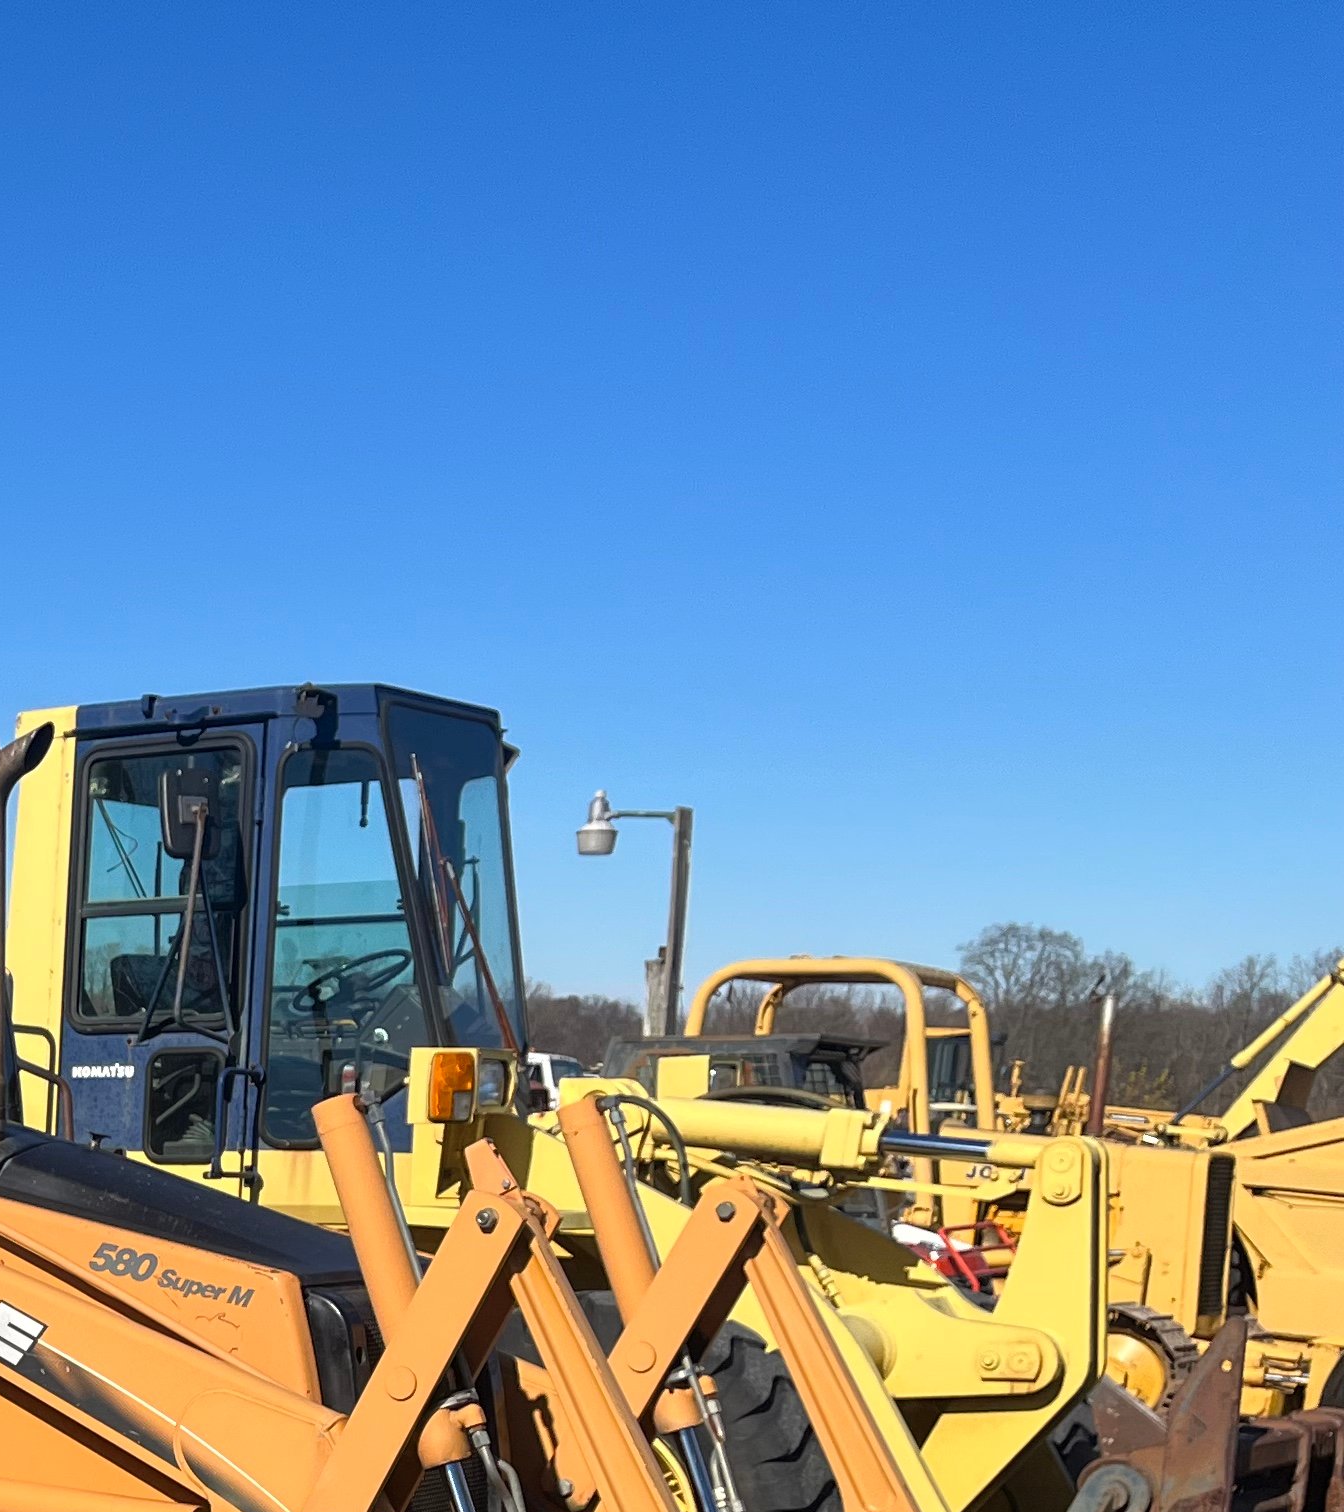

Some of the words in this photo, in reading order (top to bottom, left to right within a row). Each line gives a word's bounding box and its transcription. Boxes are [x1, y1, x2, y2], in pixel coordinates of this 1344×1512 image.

[72, 1062, 134, 1078] KOMATSU
[89, 1242, 158, 1282] 580
[157, 1269, 227, 1299] Super
[227, 1285, 255, 1307] M
